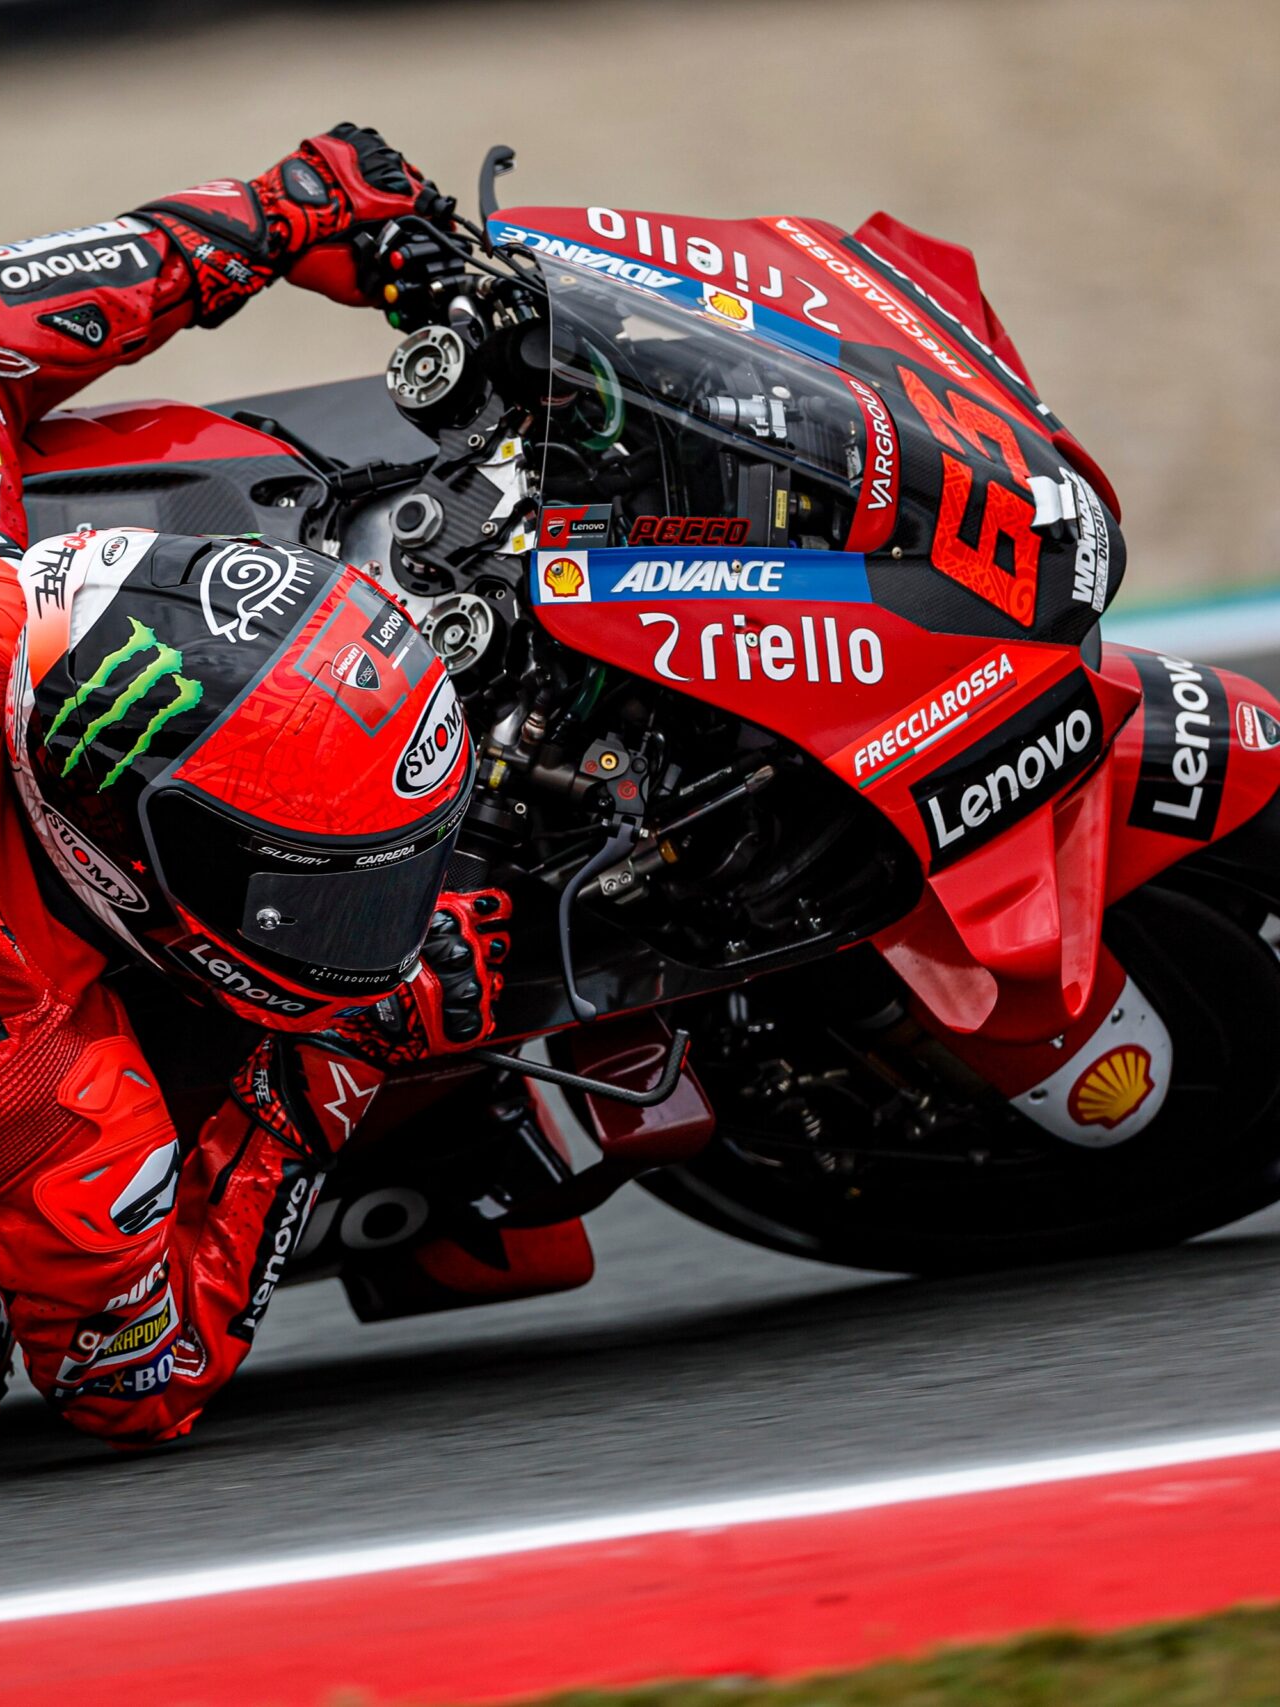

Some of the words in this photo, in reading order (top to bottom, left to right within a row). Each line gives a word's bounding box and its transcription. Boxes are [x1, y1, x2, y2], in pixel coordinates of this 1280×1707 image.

[0, 242, 150, 290] Lenovo
[496, 226, 684, 289] ADVANCE
[586, 206, 784, 299] riello
[775, 219, 973, 379] FRECCIAROSSA
[848, 380, 895, 513] VARGROUP
[571, 521, 606, 532] Lenovo
[896, 364, 1041, 627] 63
[627, 515, 752, 547] PECCO
[610, 559, 786, 593] ADVANCE
[335, 646, 361, 677] DUCATI
[699, 613, 885, 684] riello
[853, 651, 1015, 777] FRECCIAROSSA
[927, 708, 1093, 850] Lenovo
[48, 812, 137, 905] SUOMY
[257, 846, 332, 866] SUOMY
[355, 844, 415, 866] CARRERA
[188, 943, 306, 1013] Lenovo
